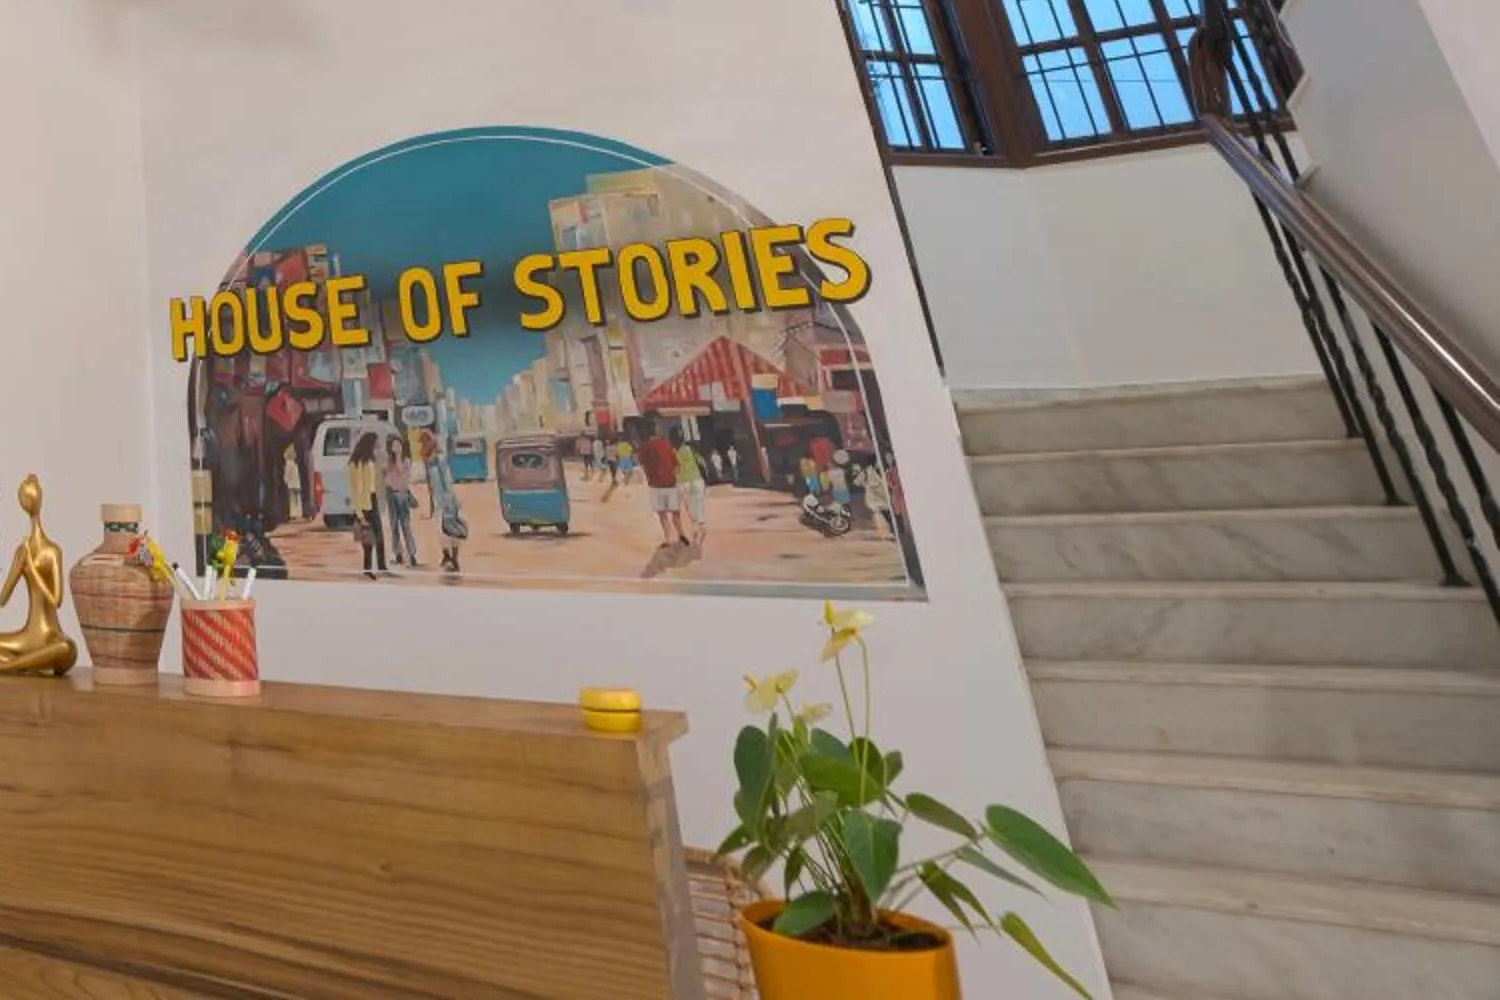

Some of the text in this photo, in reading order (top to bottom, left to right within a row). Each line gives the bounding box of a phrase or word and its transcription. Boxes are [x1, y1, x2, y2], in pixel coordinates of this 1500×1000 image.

[169, 217, 871, 361] HOUSE OF STORIES
